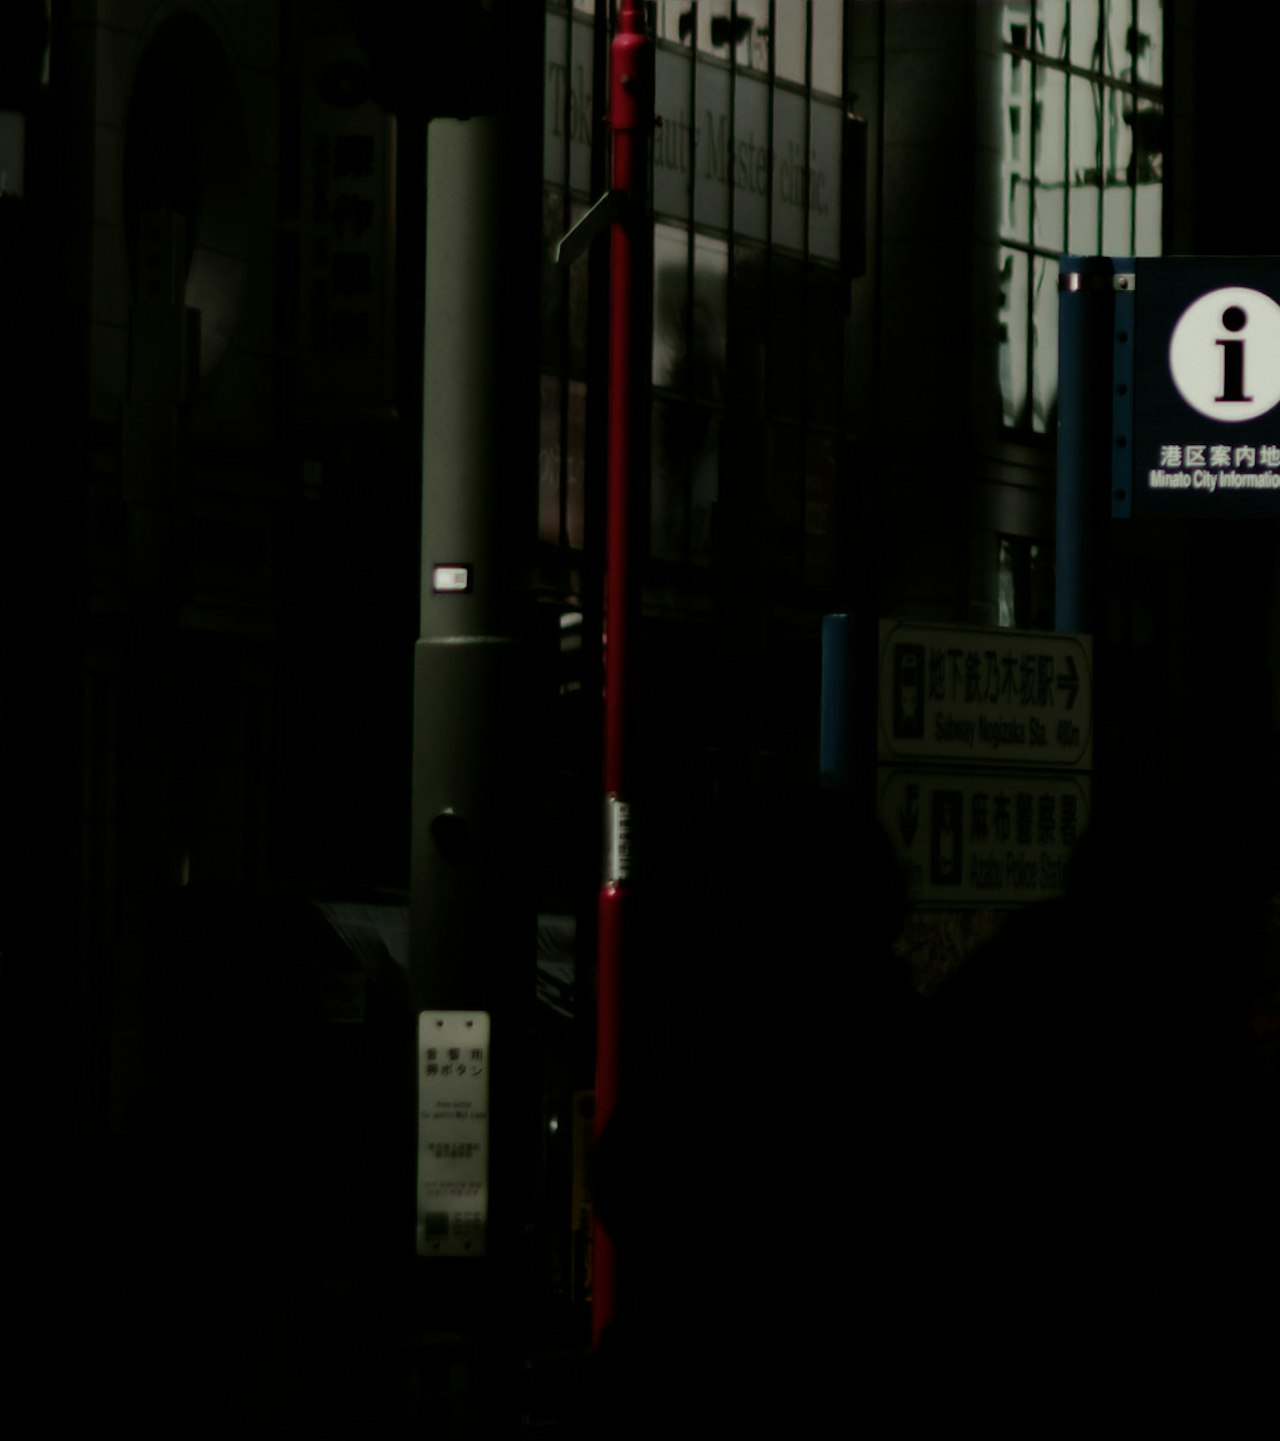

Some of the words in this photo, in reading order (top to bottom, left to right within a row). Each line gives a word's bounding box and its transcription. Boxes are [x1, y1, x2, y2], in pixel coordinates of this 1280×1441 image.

[1149, 469, 1192, 489] Minato
[1192, 469, 1218, 493] City
[928, 648, 1055, 707] 地下鉄乃木坂駅
